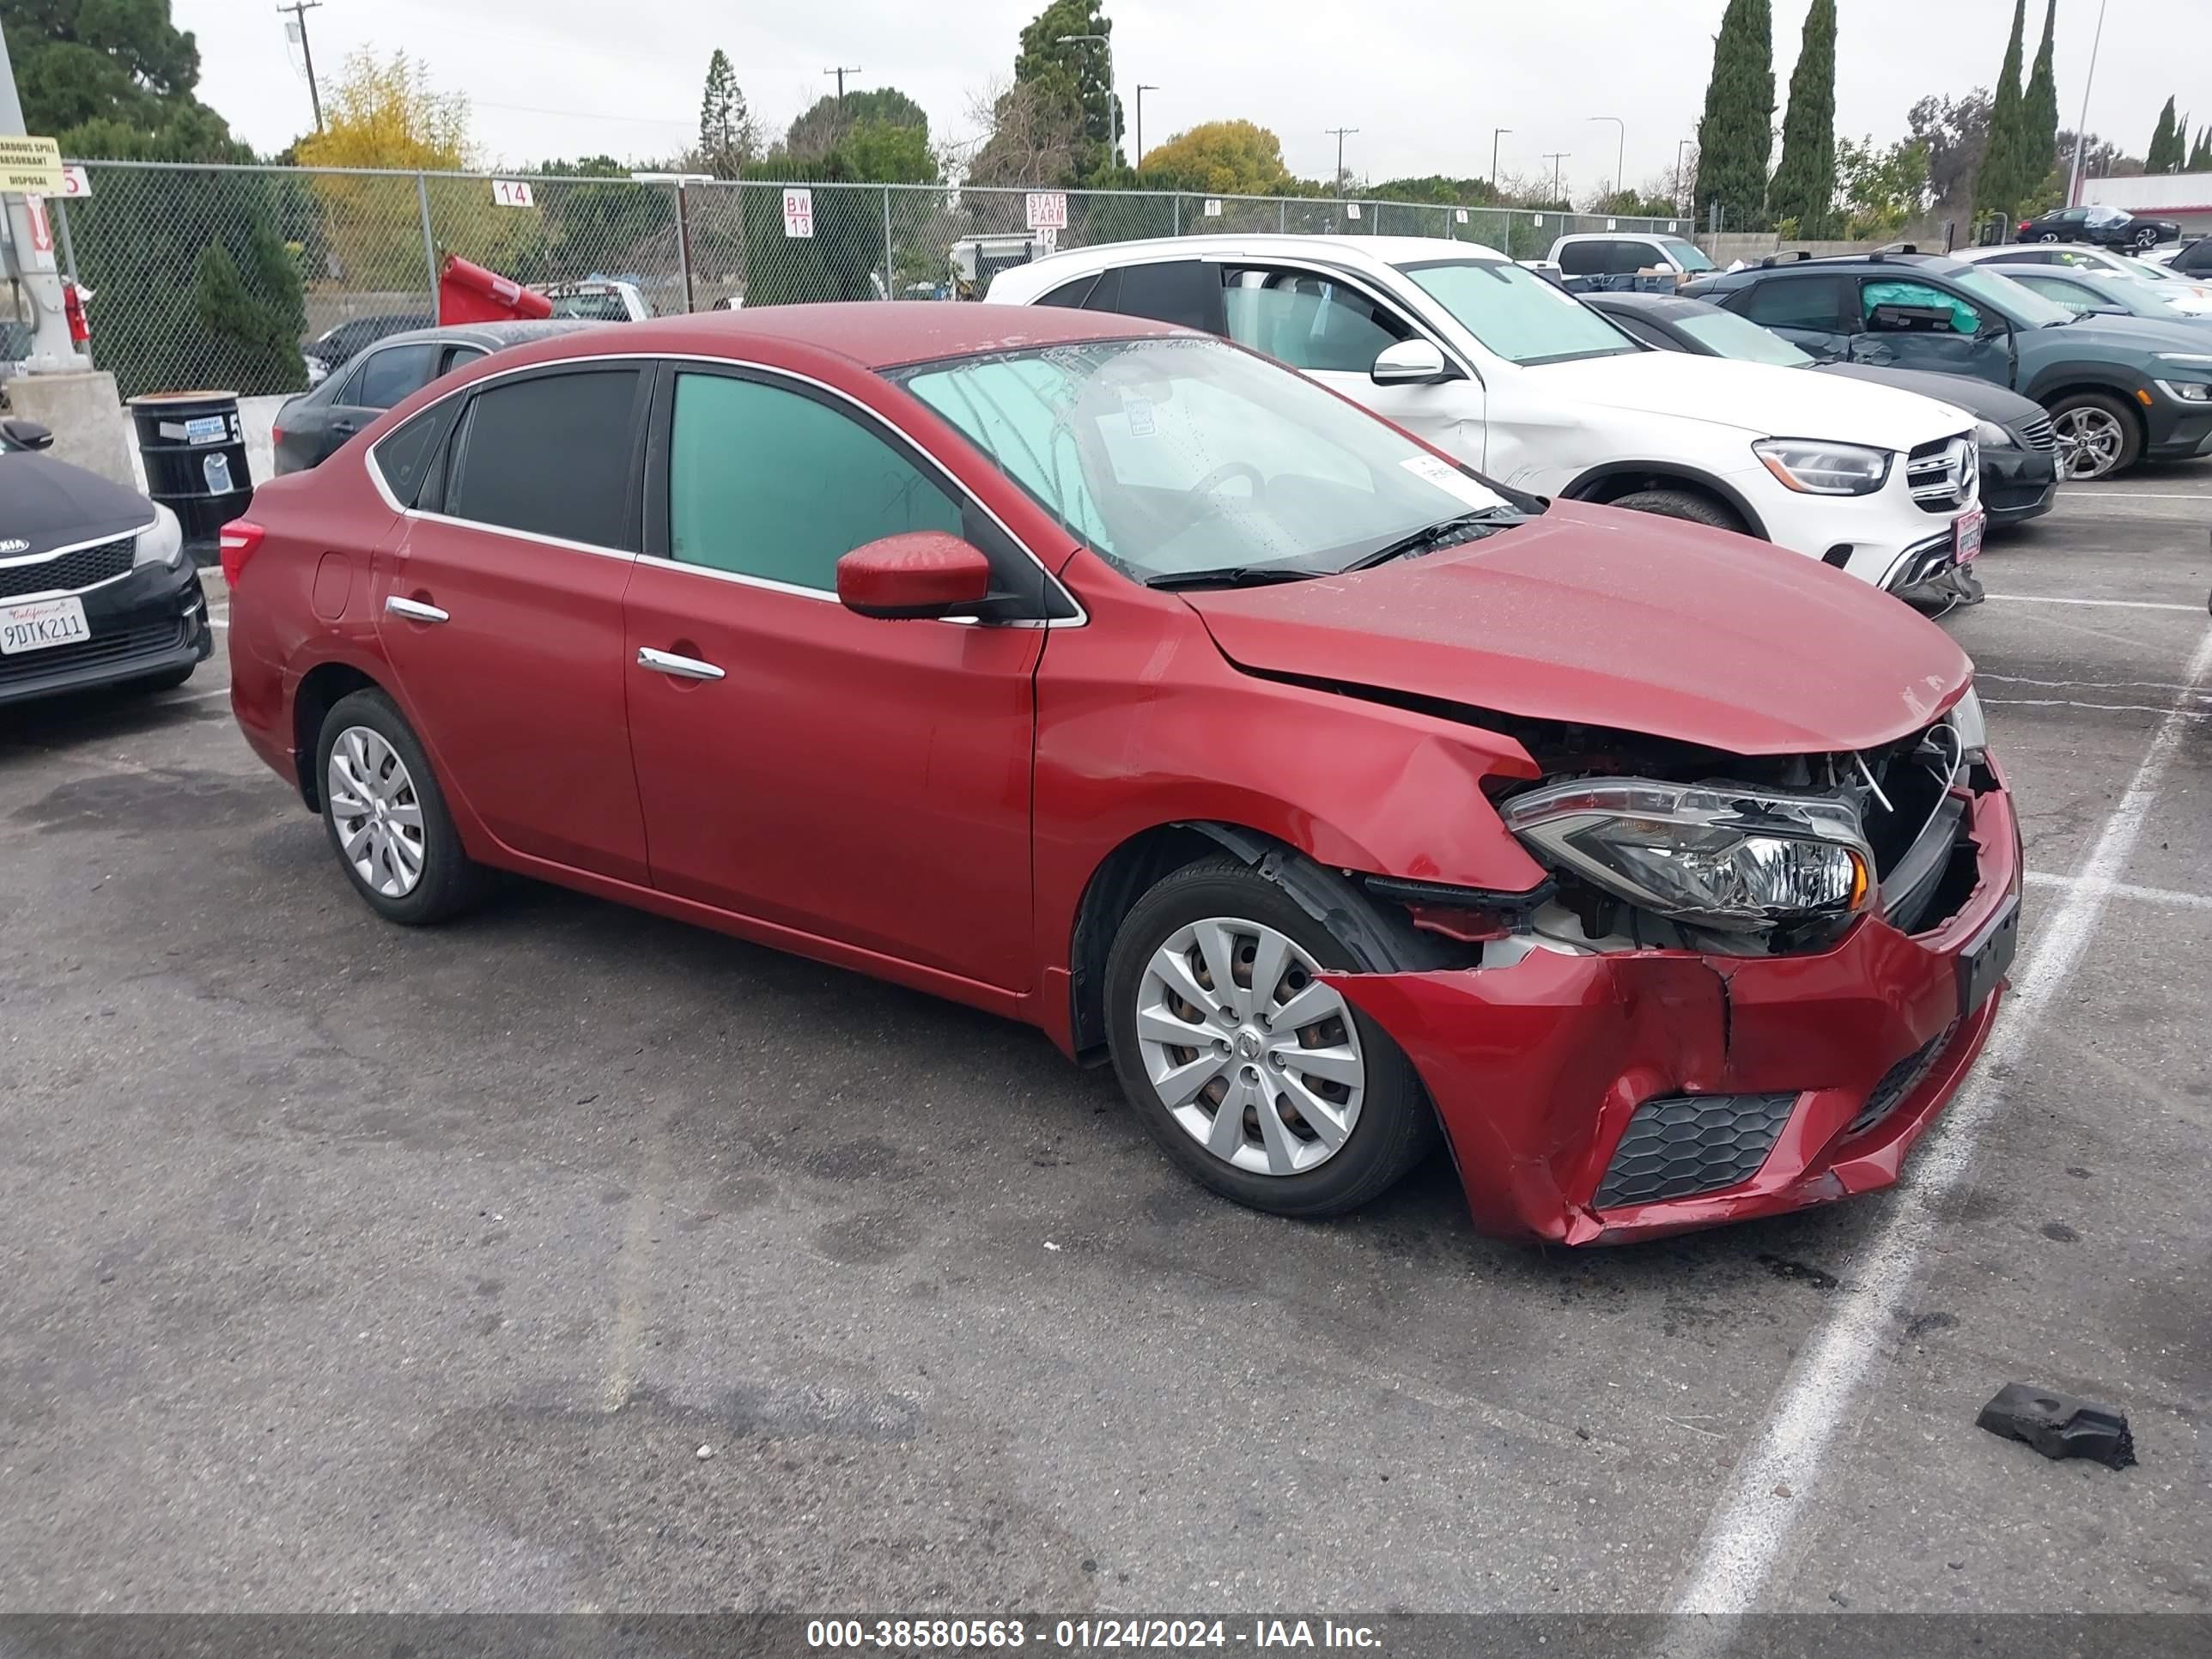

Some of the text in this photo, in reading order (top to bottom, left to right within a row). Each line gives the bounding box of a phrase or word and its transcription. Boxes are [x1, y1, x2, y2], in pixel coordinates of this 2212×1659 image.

[34, 143, 55, 153] SPILL
[9, 176, 47, 185] DISPOSAL
[501, 182, 526, 205] 14
[1030, 194, 1065, 209] STATE
[1031, 209, 1064, 222] FARM
[791, 217, 809, 235] 13
[1040, 228, 1054, 244] 12
[229, 413, 242, 443] 5
[0, 539, 25, 550] KIA
[13, 605, 61, 619] California
[3, 614, 83, 647] 9DTK211
